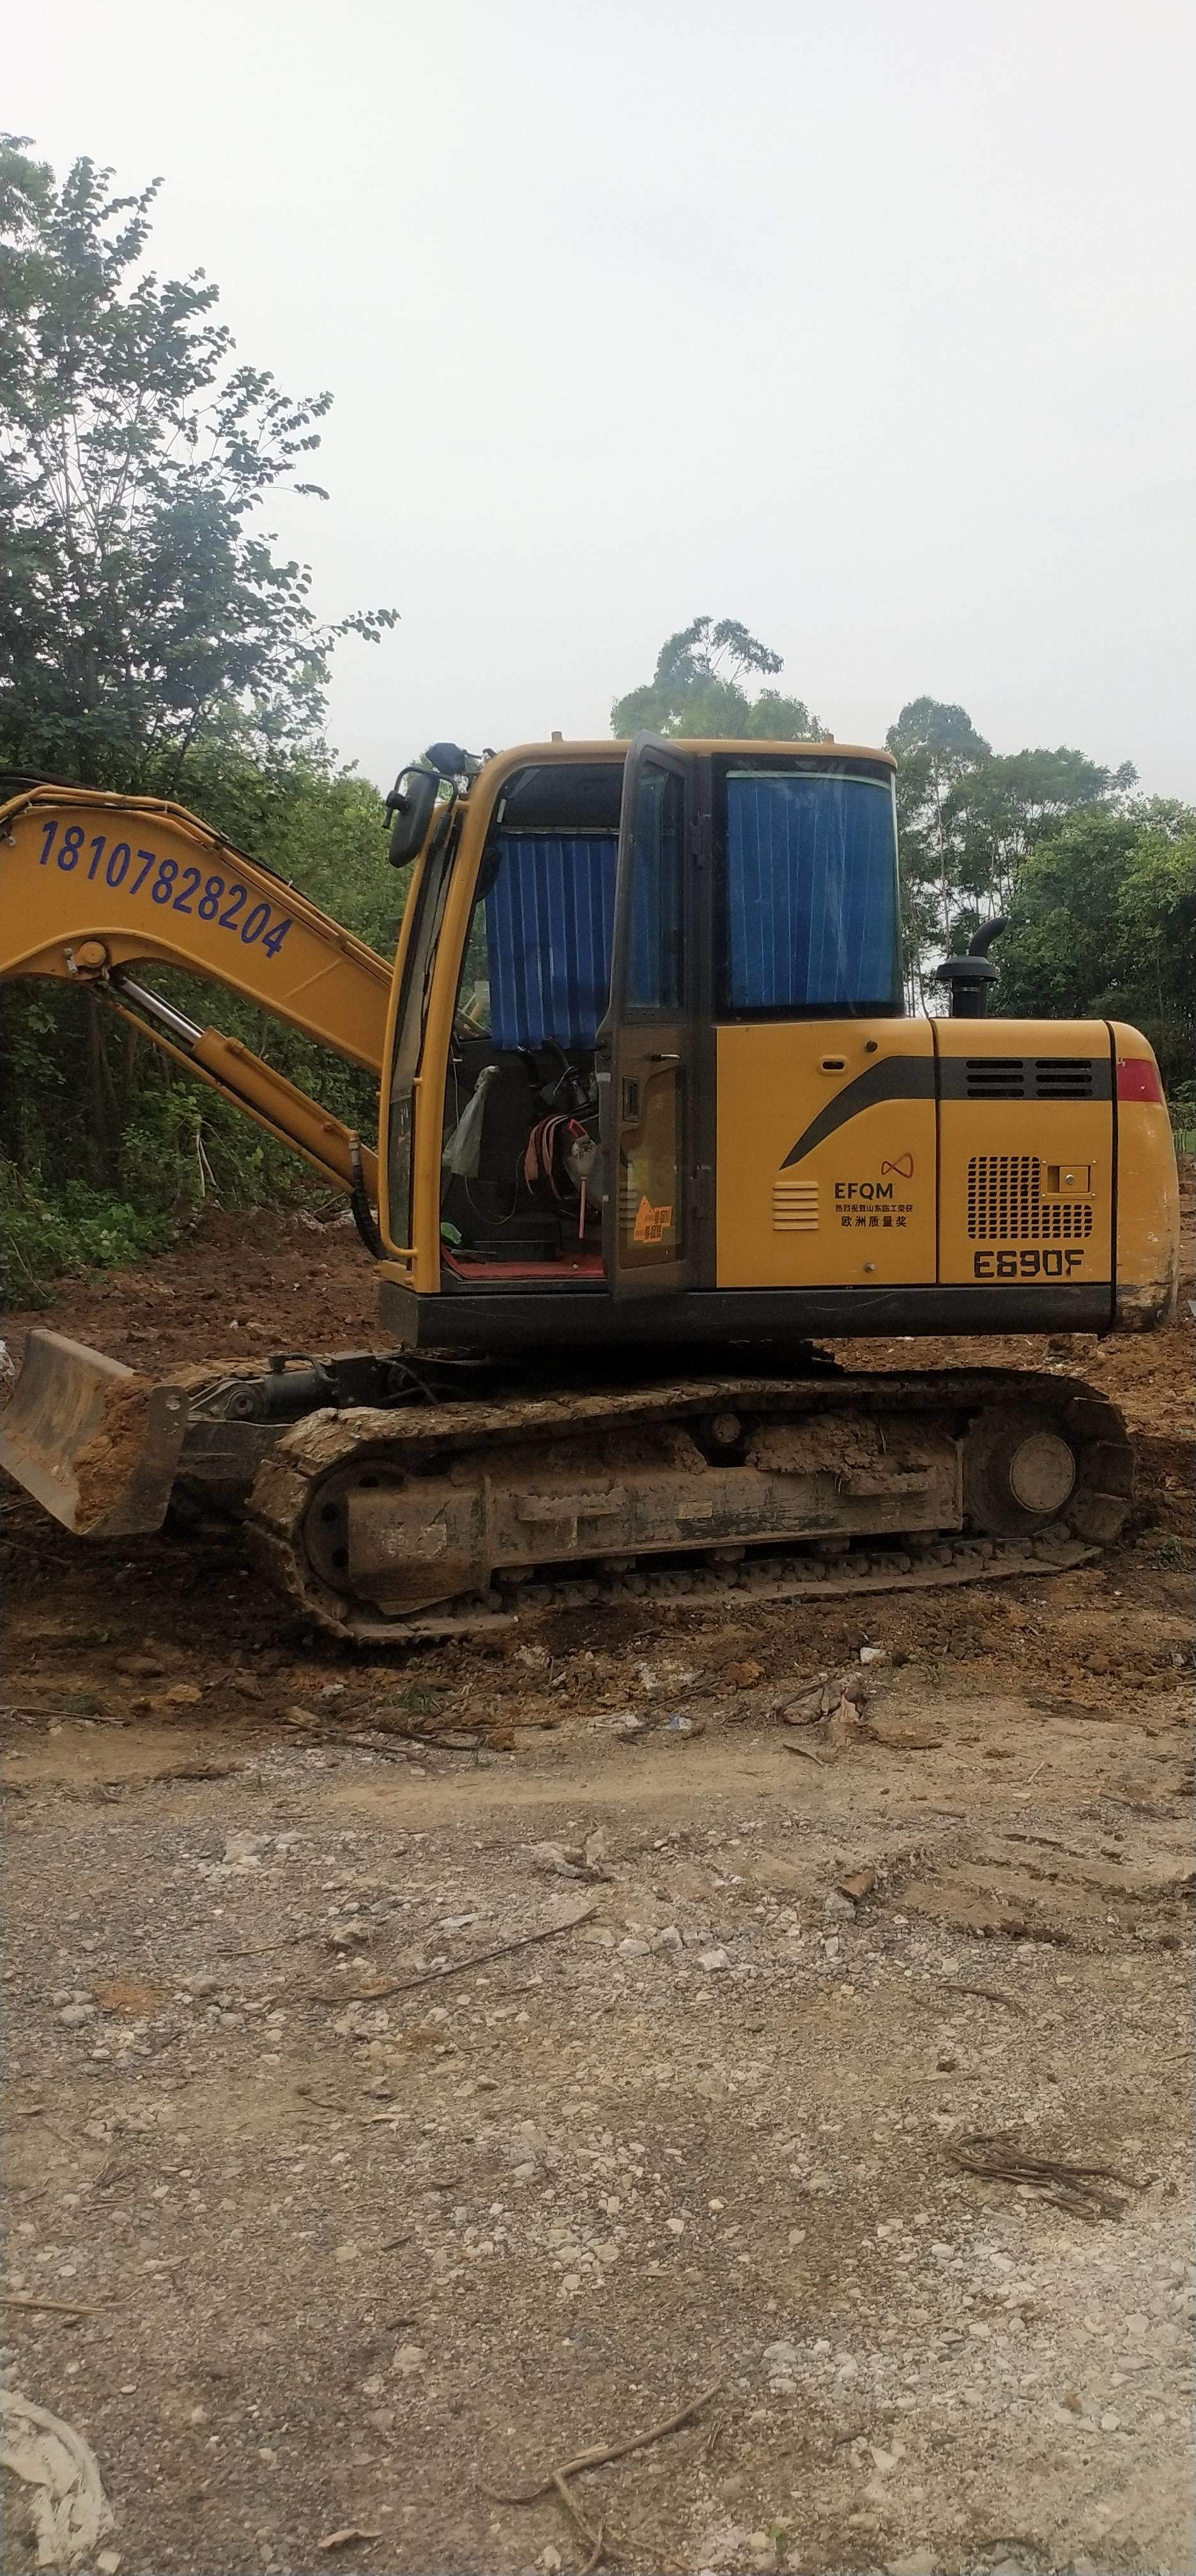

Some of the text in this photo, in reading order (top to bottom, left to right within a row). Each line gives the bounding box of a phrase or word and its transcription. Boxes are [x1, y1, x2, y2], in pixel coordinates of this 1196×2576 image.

[40, 820, 294, 958] 18107828204
[834, 1183, 893, 1200] EFQM
[835, 1204, 914, 1213] 热烈祝贺山东临工荣获
[841, 1215, 907, 1227] 欧洲质量奖
[974, 1250, 1084, 1278] E690F
